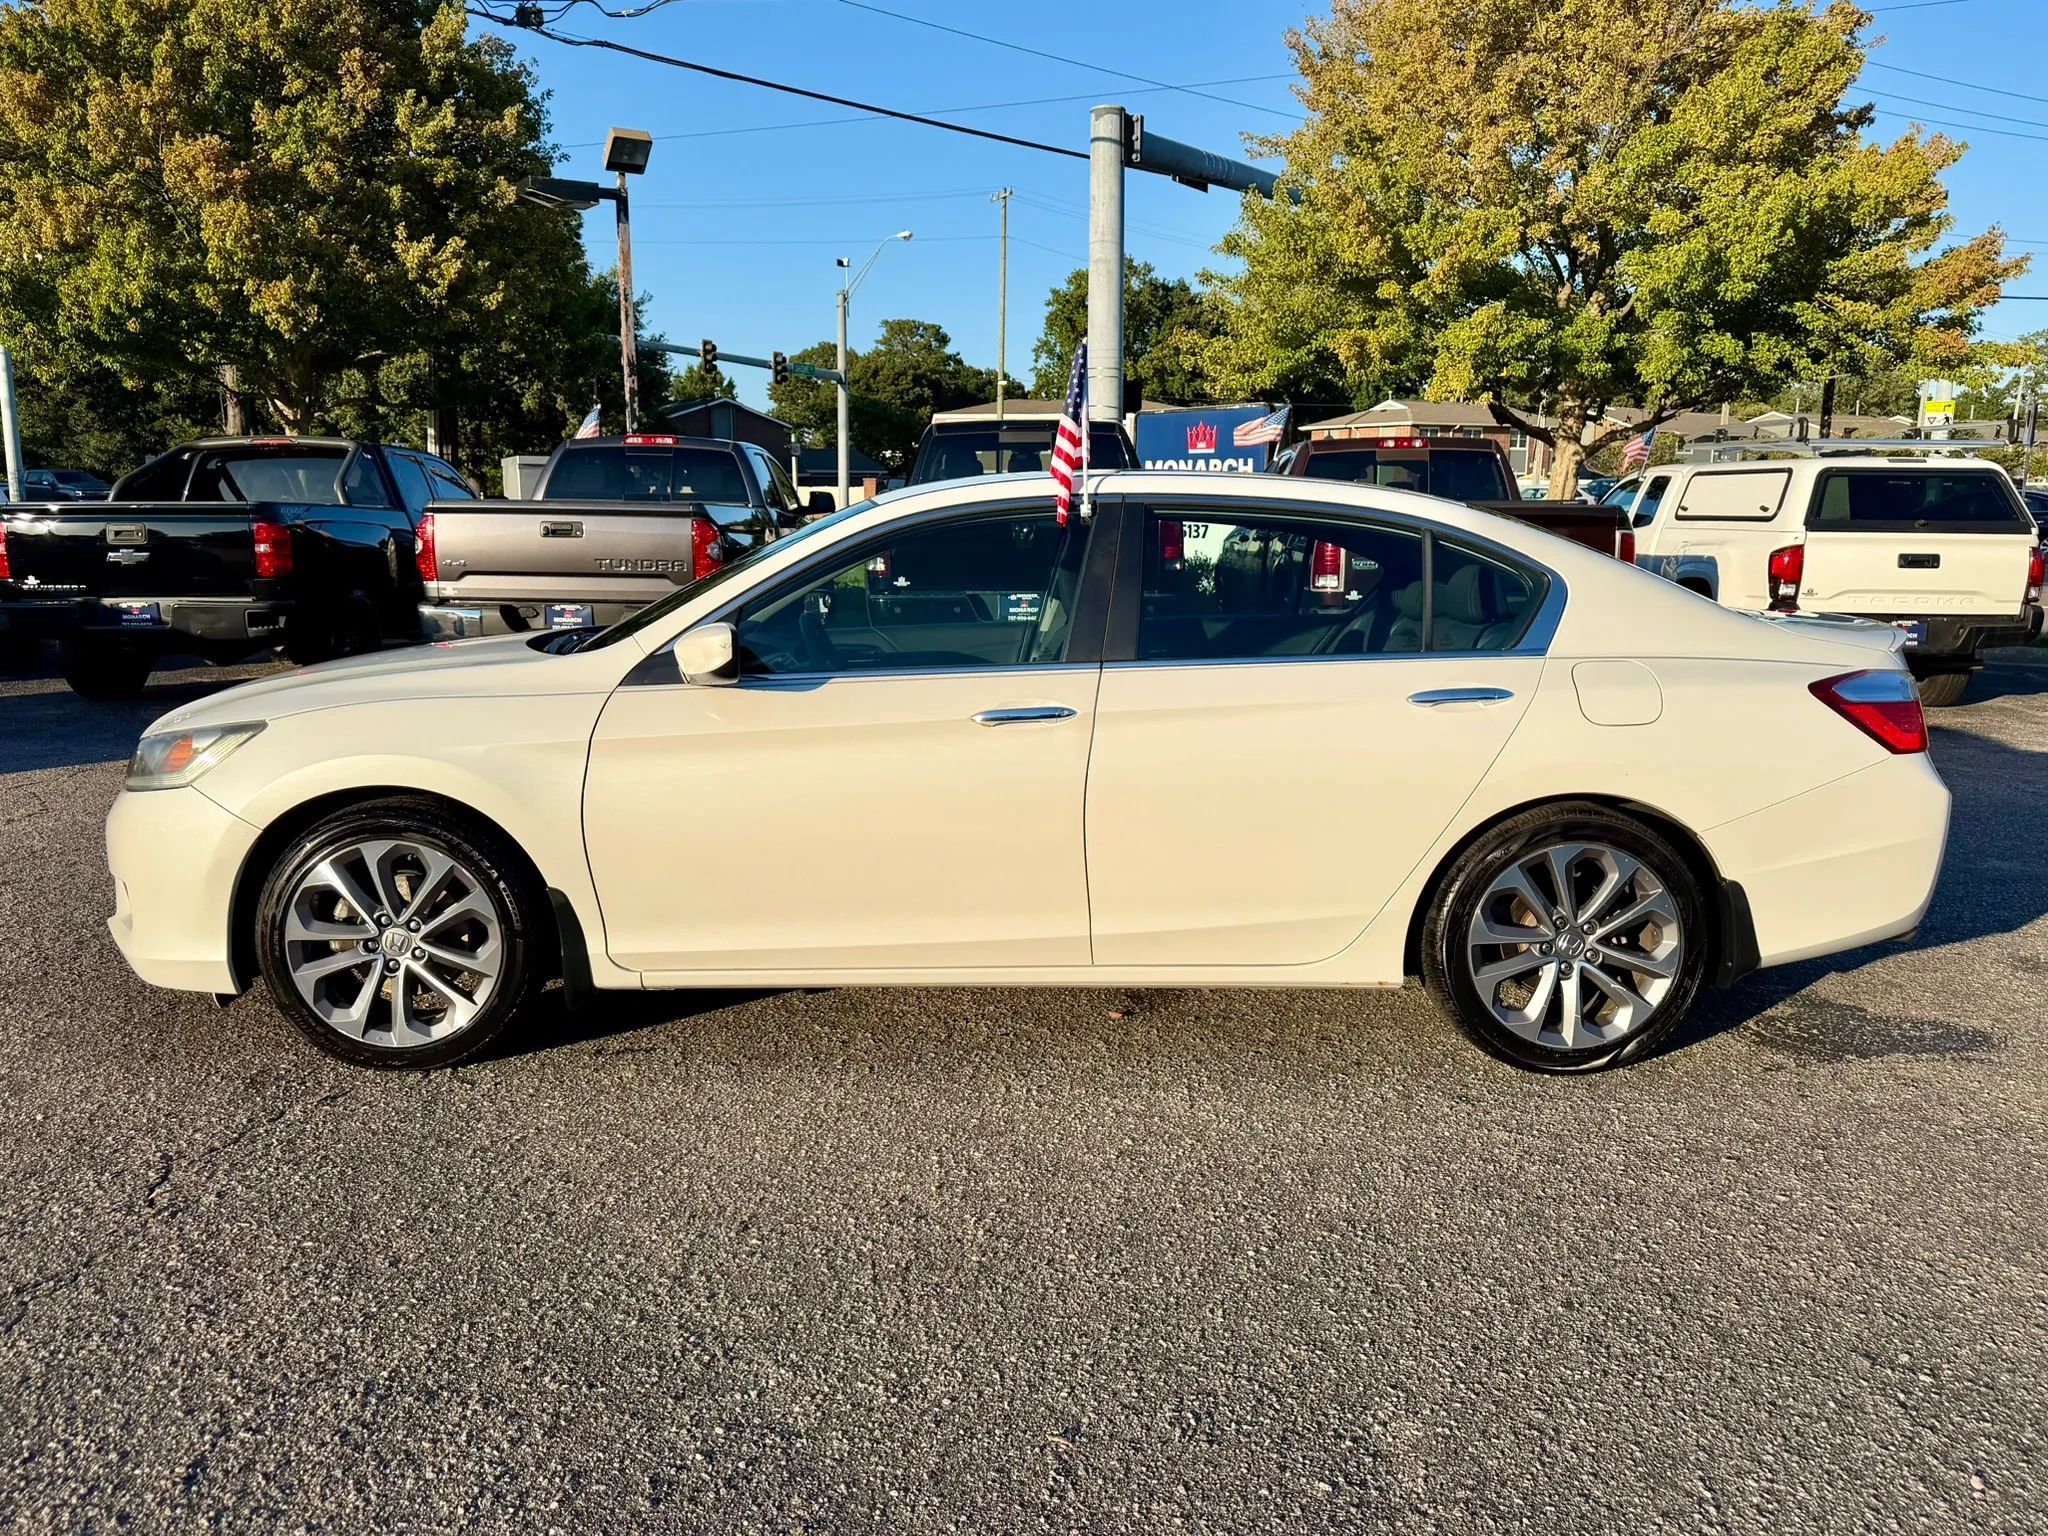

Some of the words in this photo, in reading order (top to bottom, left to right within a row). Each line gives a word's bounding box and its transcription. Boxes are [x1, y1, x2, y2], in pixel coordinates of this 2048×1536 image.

[1144, 458, 1254, 473] MONARCH
[594, 558, 688, 572] TUNDRA
[1848, 595, 1976, 607] TACOMA
